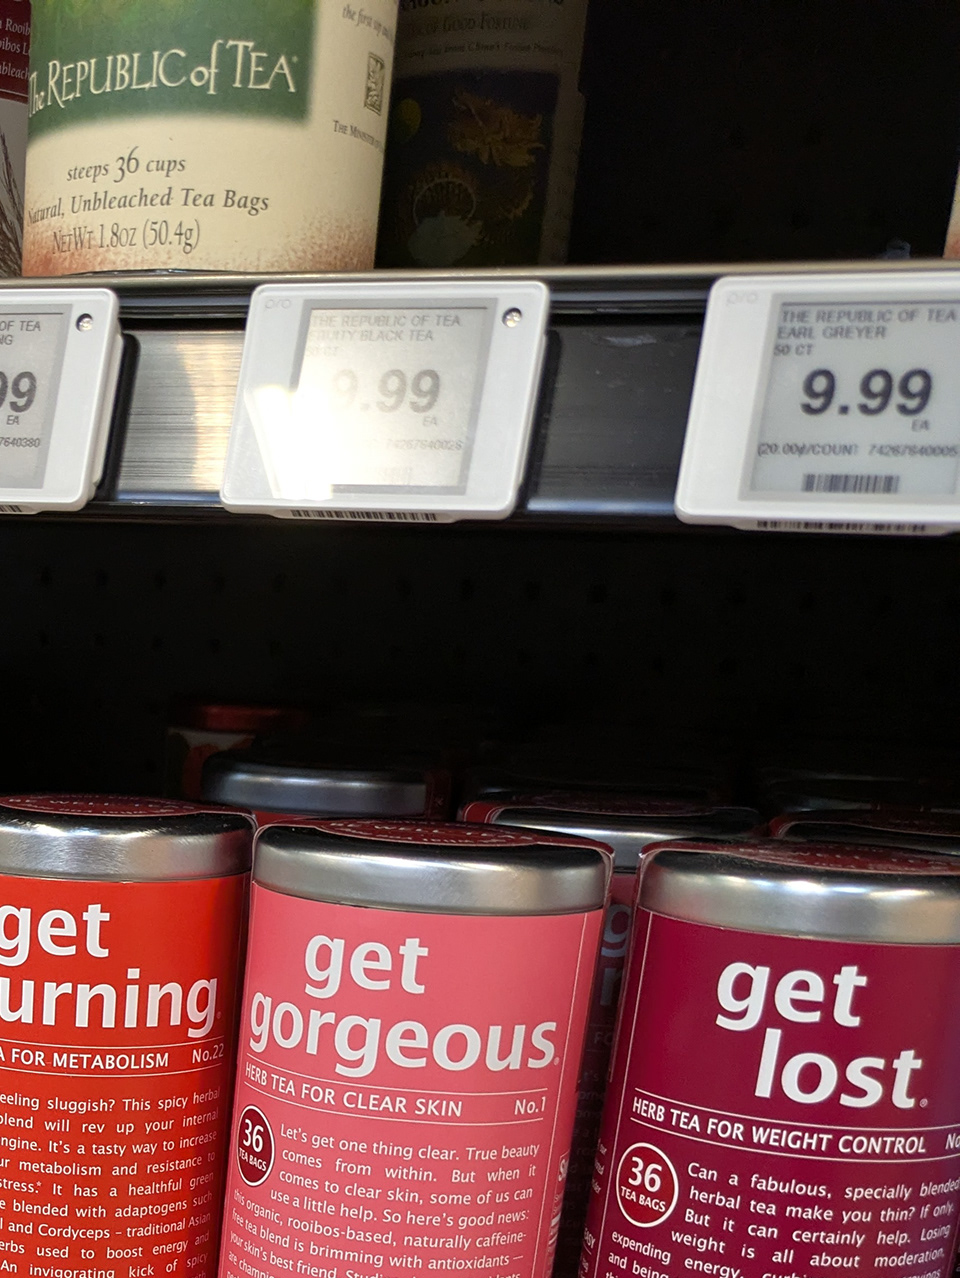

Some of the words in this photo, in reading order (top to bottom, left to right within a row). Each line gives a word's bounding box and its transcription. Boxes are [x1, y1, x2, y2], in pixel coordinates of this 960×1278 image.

[48, 49, 187, 109] REPUBLIC
[191, 40, 222, 94] of
[67, 162, 109, 182] steeps
[114, 146, 139, 182] 36
[146, 156, 186, 174] cups
[70, 188, 172, 216] Unbleached
[181, 188, 215, 208] Tea
[223, 189, 269, 216] Bags
[777, 327, 815, 339] EARL
[823, 327, 886, 339] GREYER
[801, 369, 933, 415] 9.99
[304, 934, 429, 998] get
[715, 961, 867, 1031] get
[12, 1049, 45, 1066] FOR
[52, 1052, 169, 1070] METABOLISM
[192, 1043, 224, 1064] No.22
[245, 1061, 267, 1085] HERB
[272, 1075, 295, 1096] TEA
[302, 1083, 335, 1105] FOR
[343, 1091, 406, 1113] CLEAR
[415, 1099, 462, 1117] SKIN
[514, 1097, 546, 1115] No.1
[243, 1119, 263, 1152] 36
[633, 1096, 665, 1122] HERB
[670, 1109, 700, 1132] TEA
[707, 1118, 744, 1142] FOR
[752, 1126, 832, 1151] WEIGHT
[838, 1135, 926, 1154] CONTROL
[239, 1146, 249, 1163] TEA
[249, 1154, 267, 1172] BAGS
